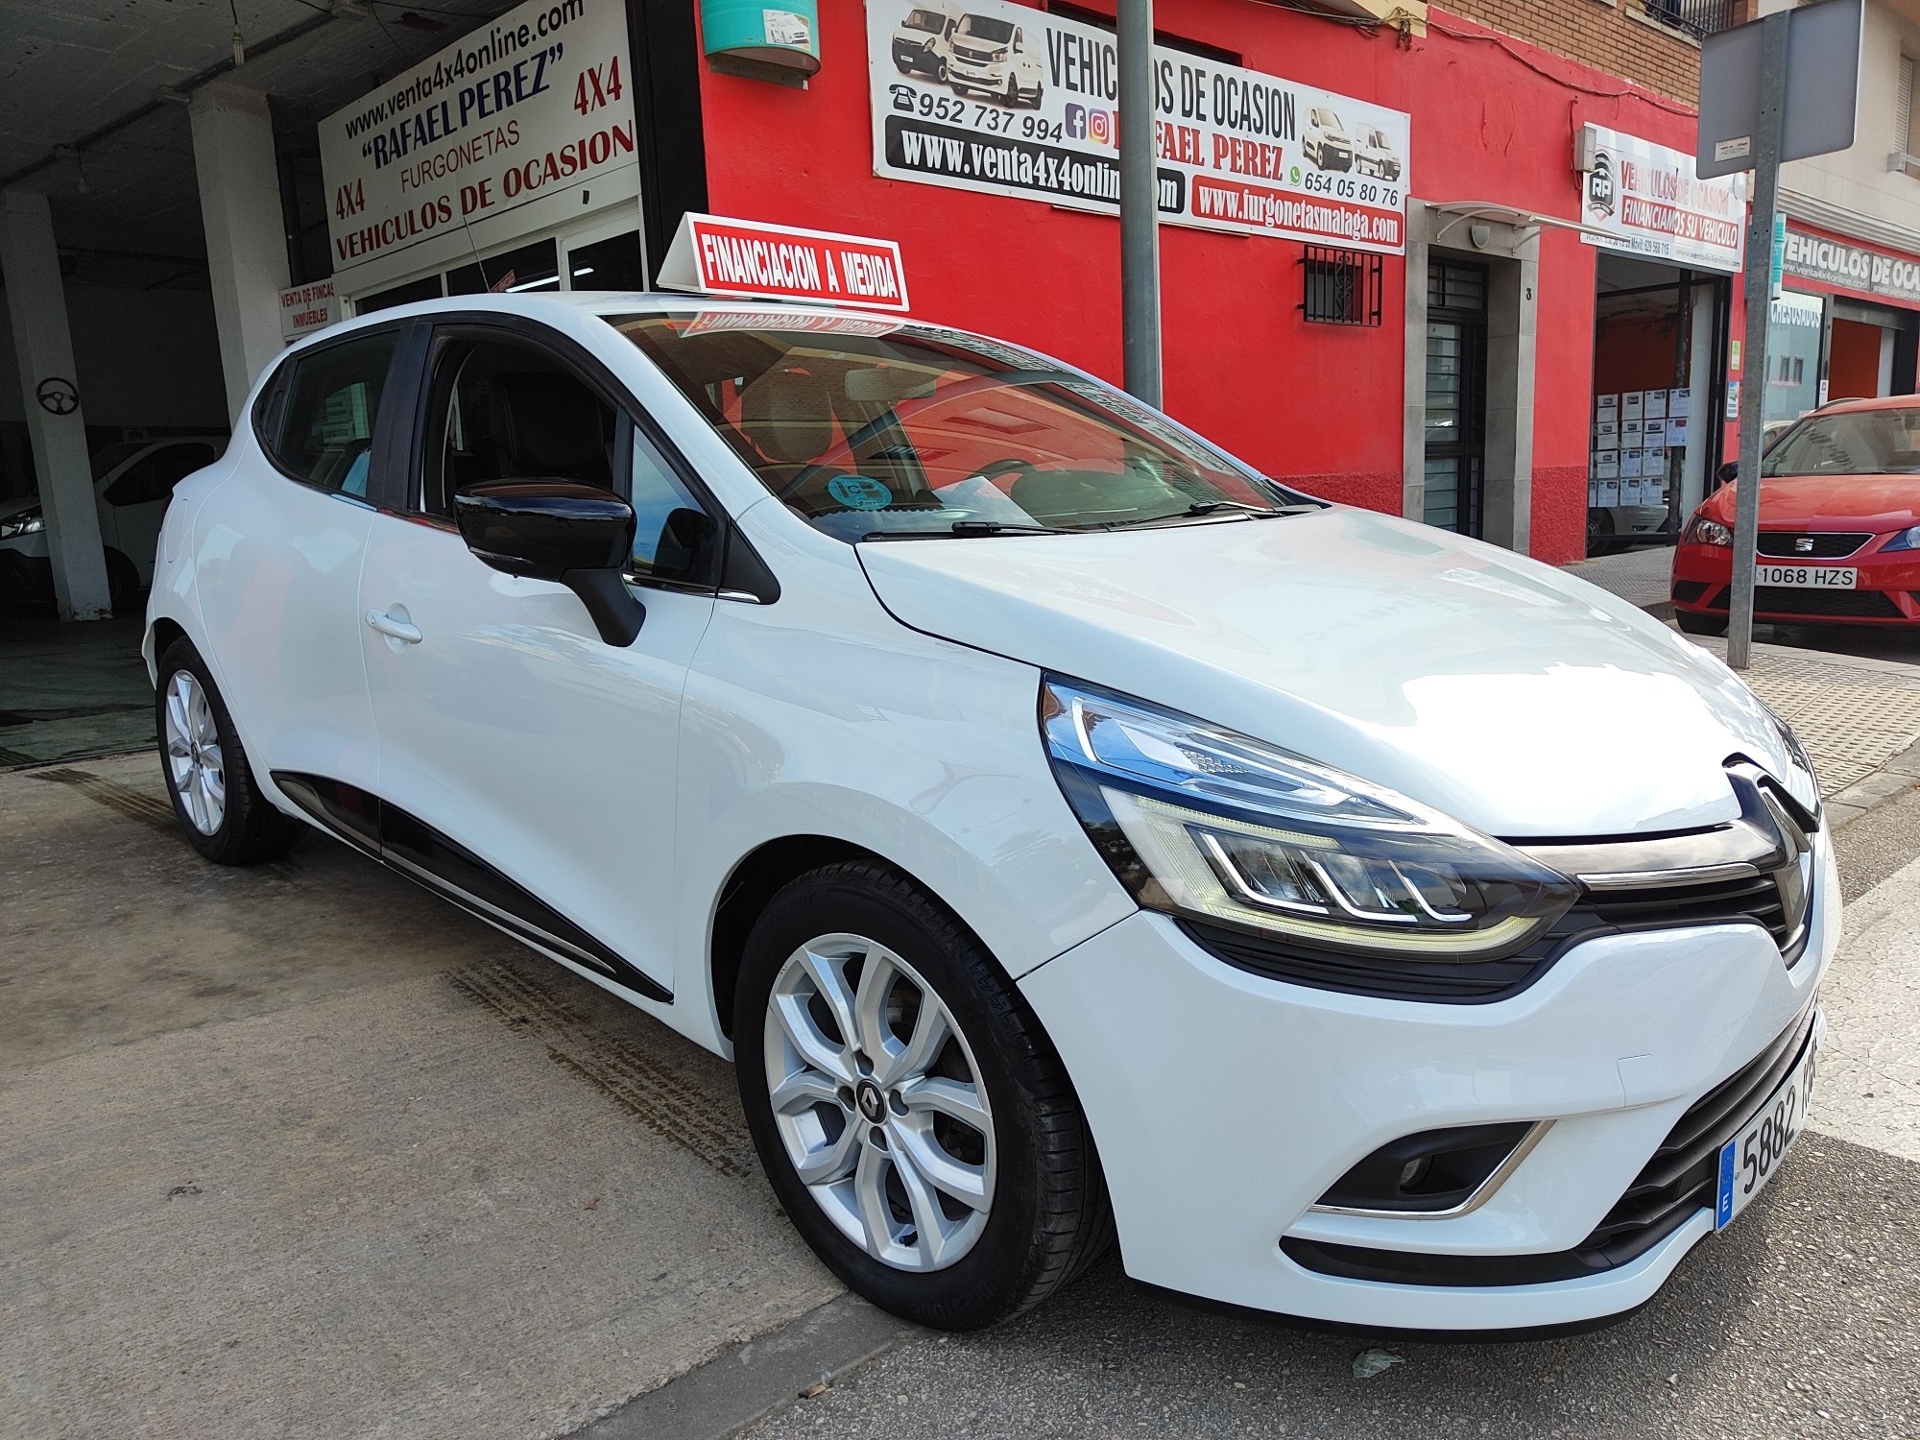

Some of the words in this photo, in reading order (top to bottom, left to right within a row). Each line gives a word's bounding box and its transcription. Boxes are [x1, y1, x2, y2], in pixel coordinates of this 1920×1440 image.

[345, 0, 584, 140] www.venta4x4online.com
[1046, 27, 1174, 114] VEHICS
[1180, 64, 1207, 122] DE
[1213, 73, 1296, 141] OCASION
[918, 93, 965, 123] 952
[974, 104, 1015, 133] 737
[1022, 115, 1063, 143] 994
[401, 119, 520, 194] FURGONETAS
[901, 130, 1178, 208] www.venta4x4onlinm
[1113, 111, 1204, 166] FAEL
[1212, 133, 1283, 181] PEREZ
[336, 196, 452, 261] VEHICULOS
[460, 178, 495, 217] DE
[503, 119, 634, 199] OCASION
[1199, 185, 1398, 244] www.furgonetasmalaga.com
[1304, 173, 1332, 194] 654
[1337, 178, 1355, 198] 05
[1359, 183, 1377, 202] 80
[1381, 187, 1398, 206] 76
[1621, 160, 1677, 201] VEHICULOS
[1676, 178, 1690, 206] DE
[1691, 181, 1730, 215] OCASION
[1623, 199, 1685, 236] FINANCIAMOS
[1686, 214, 1698, 238] SU
[1699, 217, 1738, 247] VEHICULO
[701, 233, 821, 291] FINANCIACION
[825, 249, 840, 293] A
[841, 251, 899, 298] MEDIDA
[1871, 255, 1892, 285] DE
[281, 291, 302, 308] VENTA
[302, 287, 312, 303] DE
[311, 282, 334, 301] FINCAS
[293, 308, 328, 328] INMUEBLES
[1525, 287, 1532, 301] 3
[1762, 567, 1807, 584] 1068
[1814, 569, 1854, 586] HZS
[1743, 1085, 1795, 1194] 5882
[1722, 1191, 1730, 1213] E
